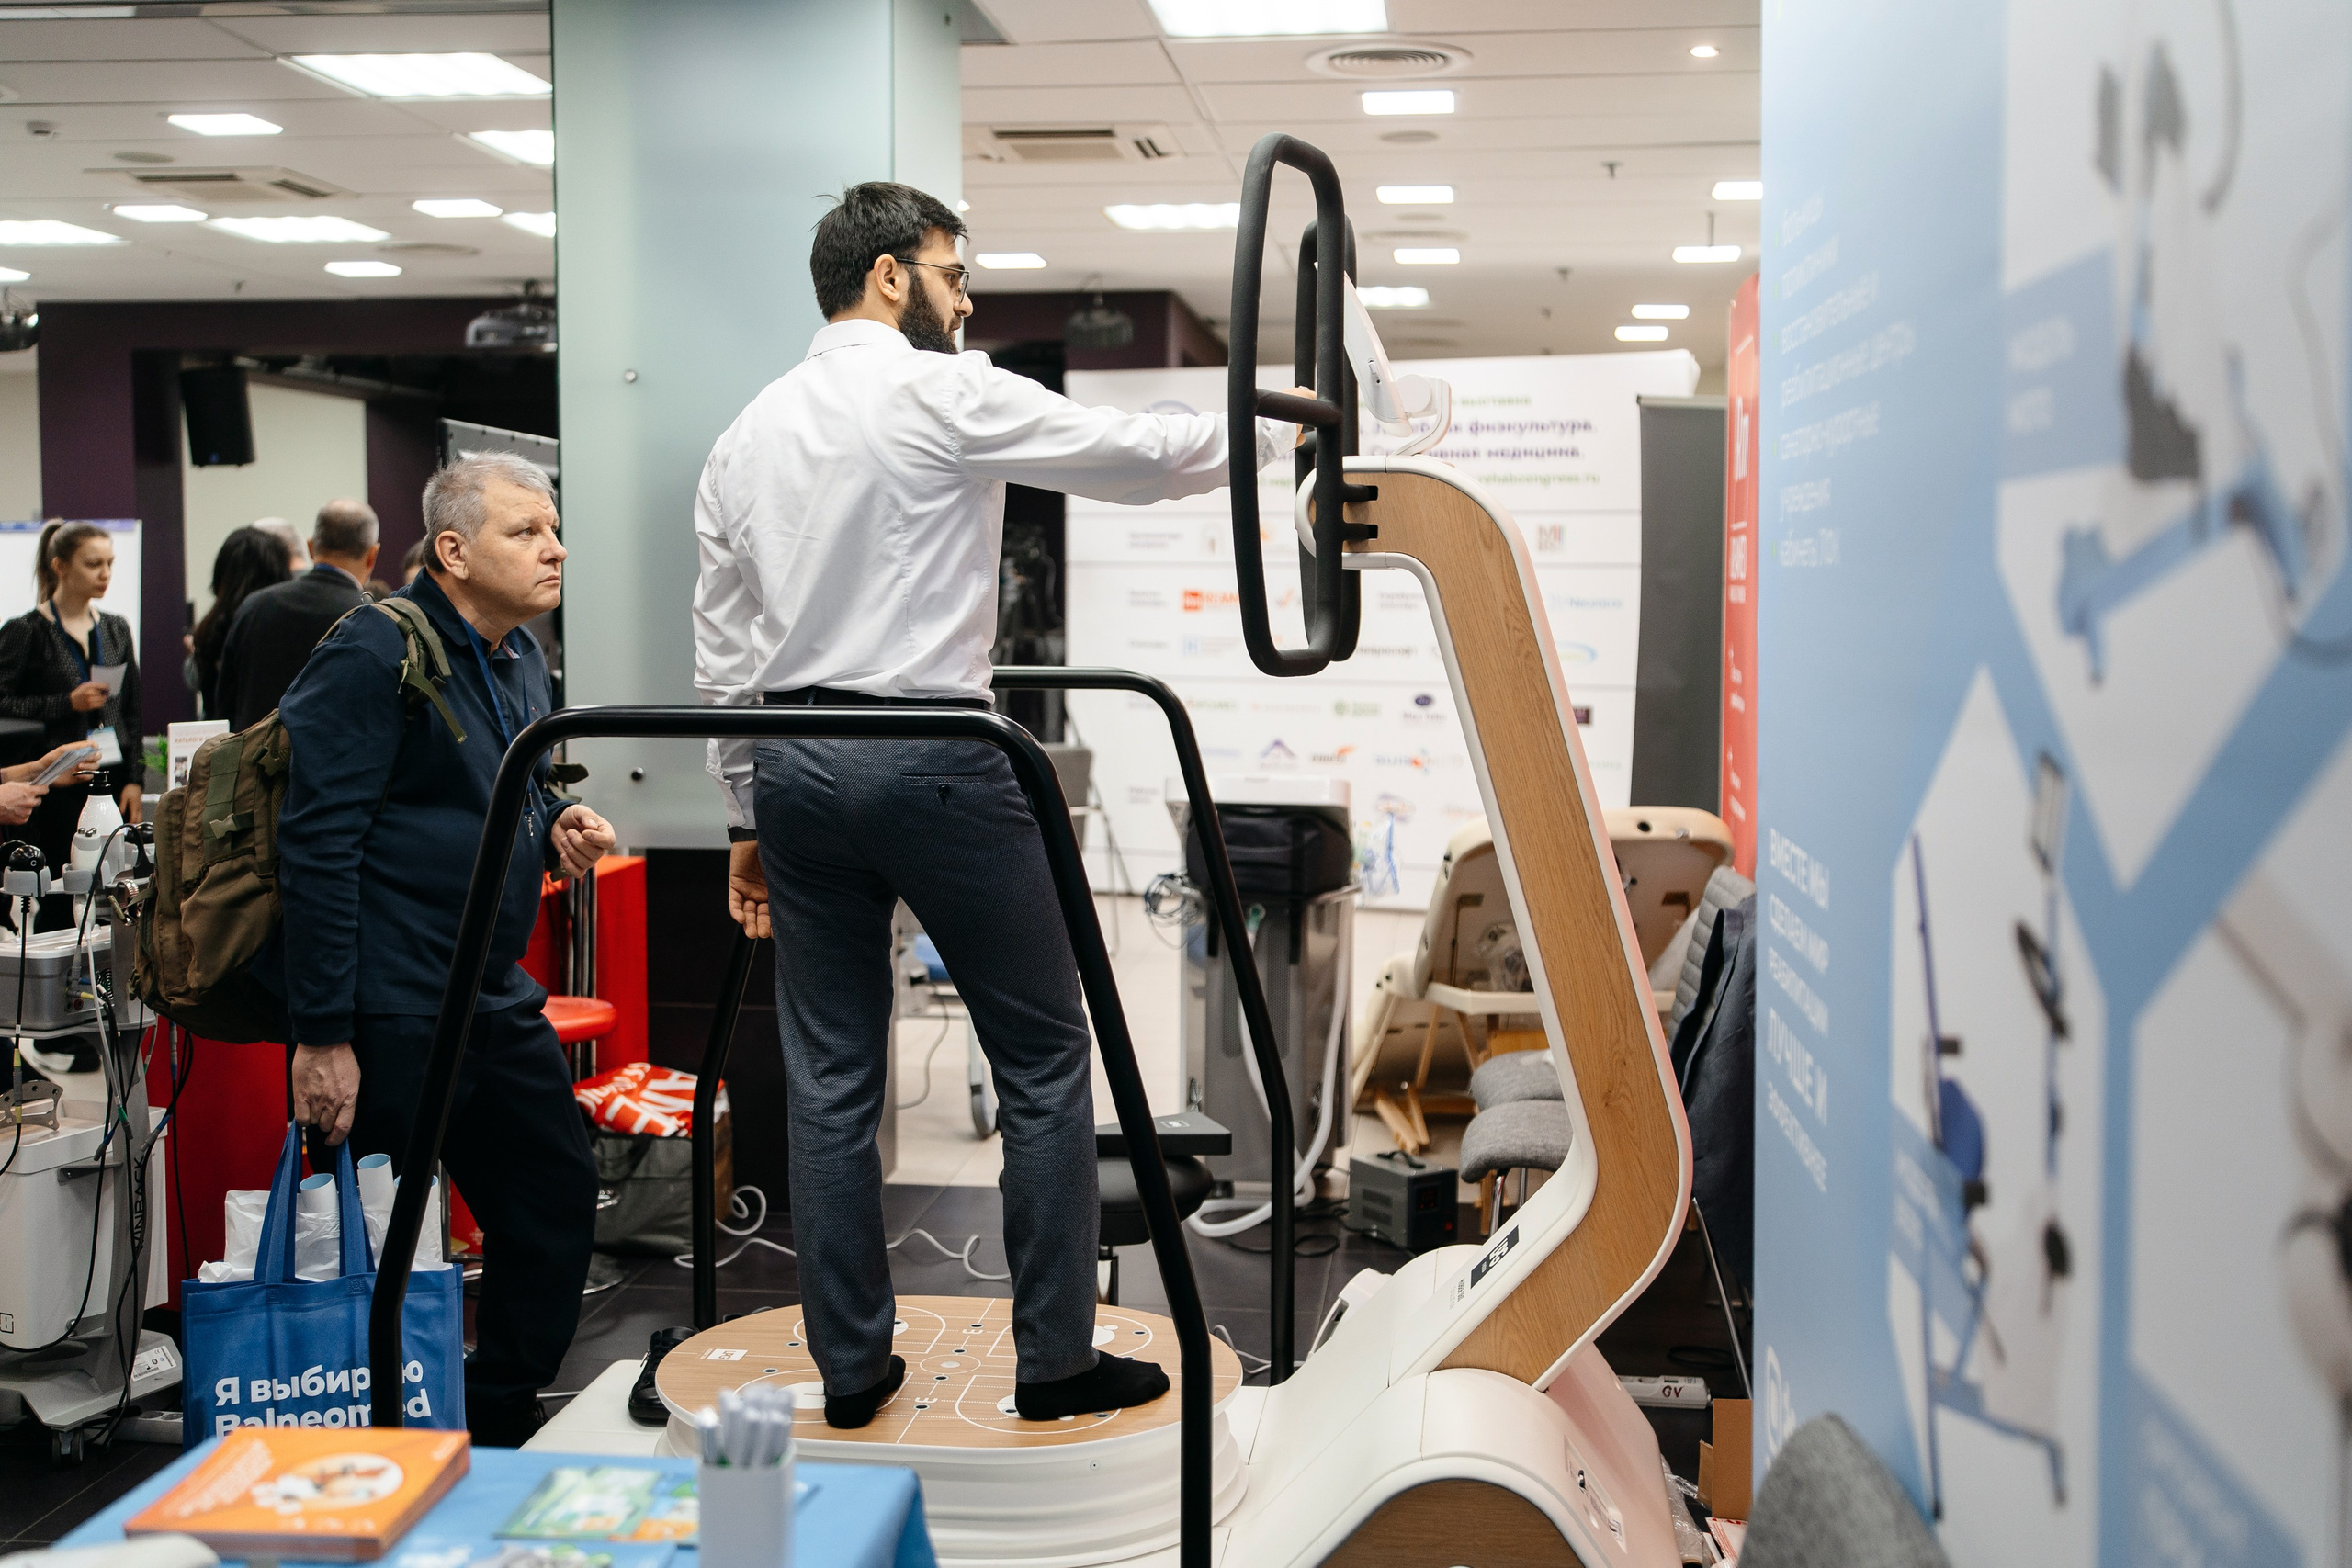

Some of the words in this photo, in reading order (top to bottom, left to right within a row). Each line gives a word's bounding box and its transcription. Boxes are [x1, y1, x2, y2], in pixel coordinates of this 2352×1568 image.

[1770, 827, 1808, 893] ВМЕСТЕ
[1808, 855, 1829, 909] МЫ
[1768, 1006, 1814, 1108] ЛУЧШЕ
[1488, 1237, 1509, 1268] LPG
[215, 1377, 240, 1406] Я
[250, 1360, 424, 1403] выбирю
[215, 1388, 432, 1438] Balneomd
